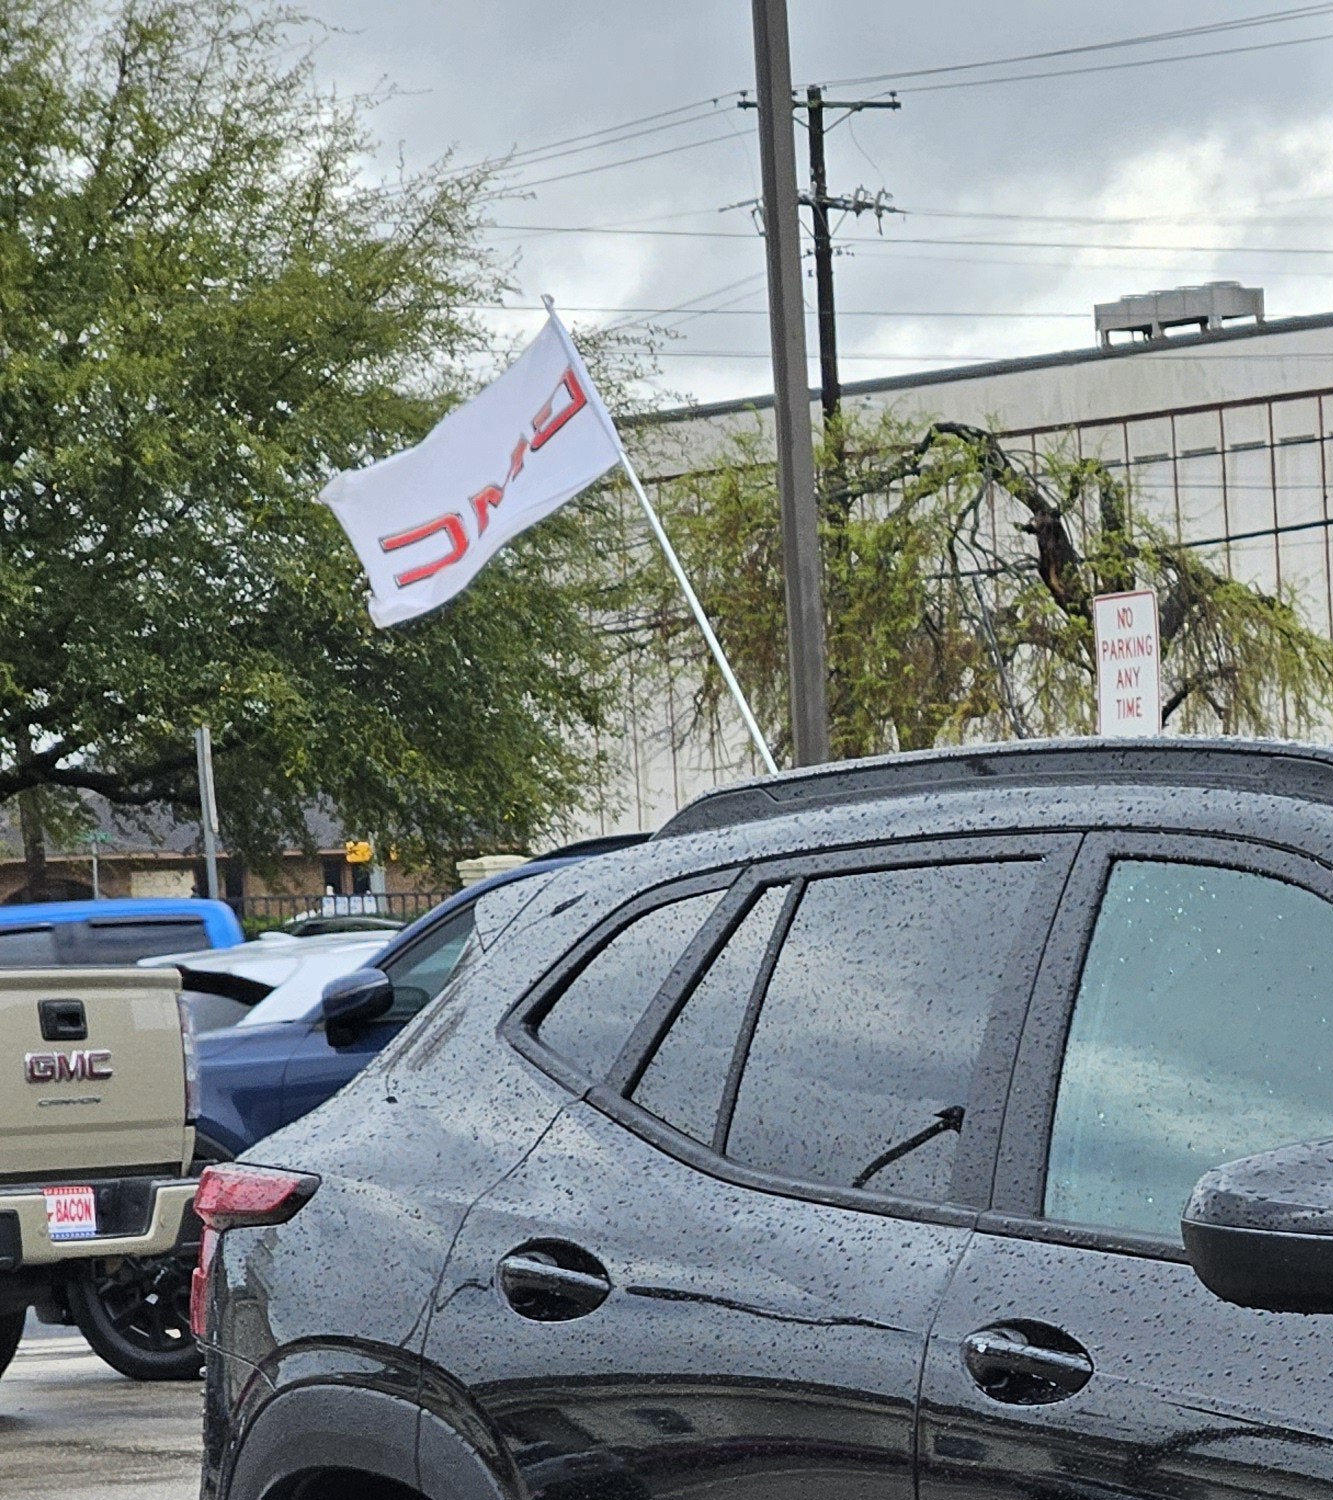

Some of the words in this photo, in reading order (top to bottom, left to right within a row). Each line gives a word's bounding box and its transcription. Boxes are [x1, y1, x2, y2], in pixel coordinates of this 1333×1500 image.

[1116, 607, 1134, 629] NO
[1101, 635, 1154, 661] PARKING
[1116, 666, 1141, 689] ANY
[1116, 697, 1143, 719] TIME
[24, 1049, 114, 1083] GMC
[55, 1198, 92, 1223] BACON
